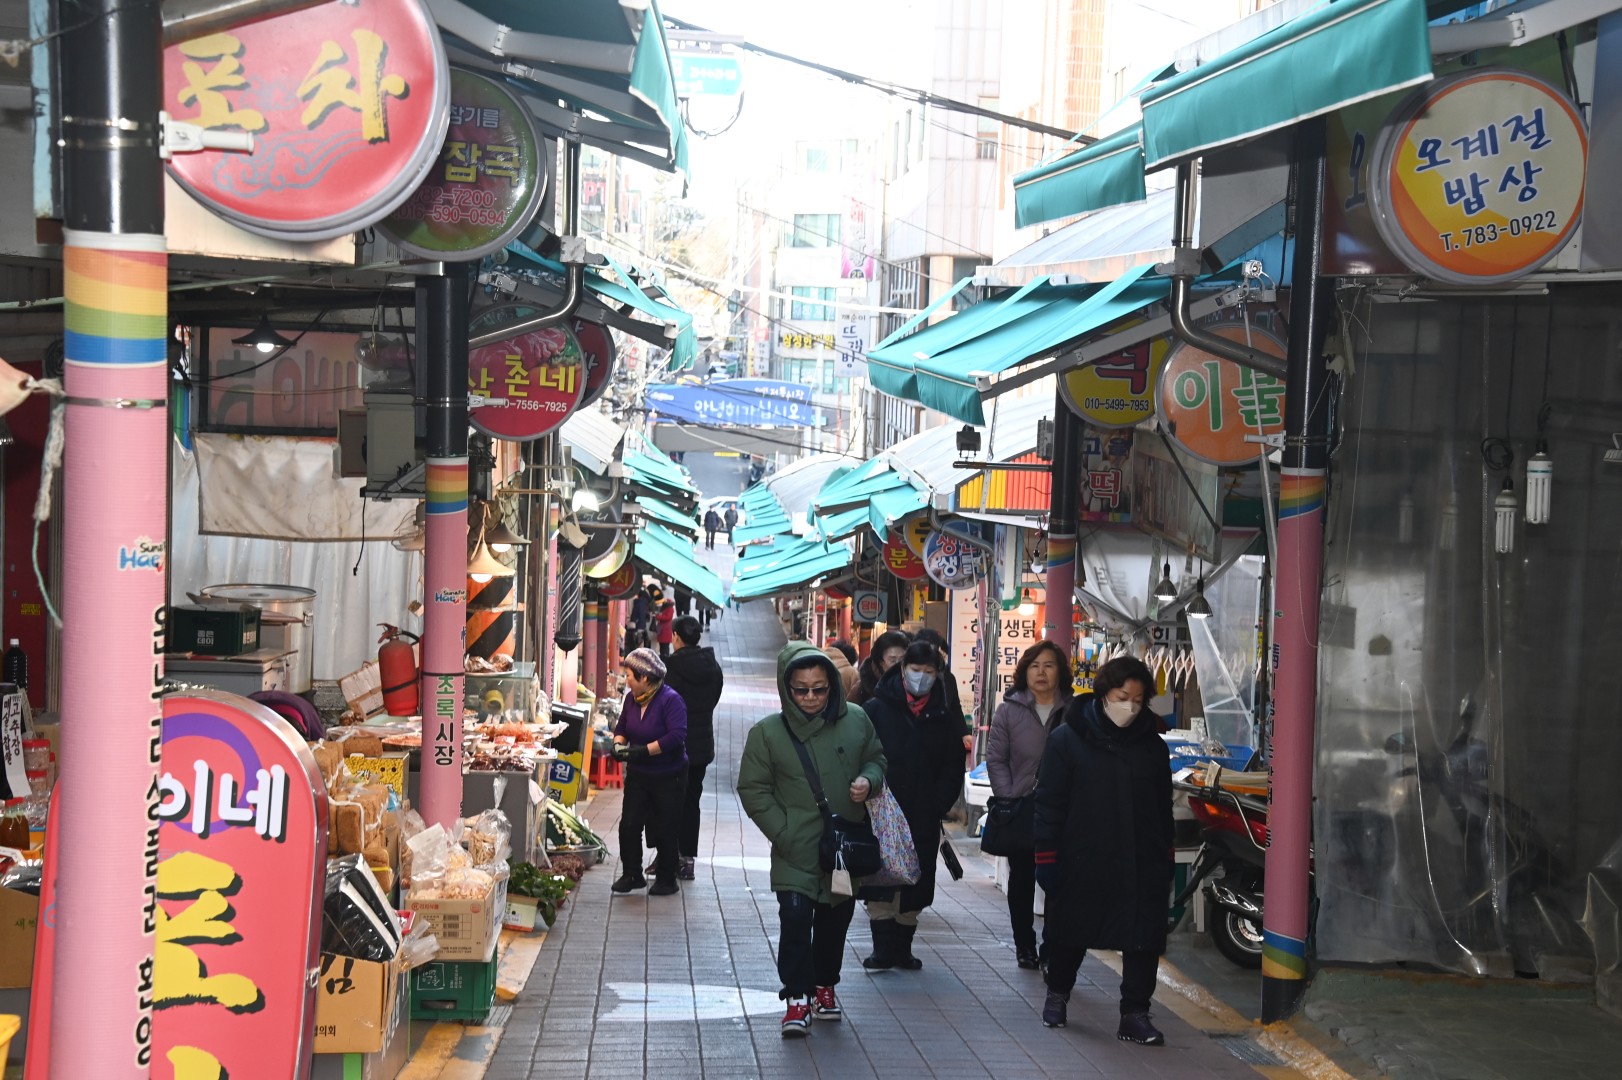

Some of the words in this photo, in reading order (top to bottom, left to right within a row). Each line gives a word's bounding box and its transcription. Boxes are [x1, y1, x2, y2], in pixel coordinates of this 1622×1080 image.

[445, 142, 520, 186] 잡곡
[1416, 108, 1552, 172] 오계절
[1444, 161, 1542, 216] 밥상
[1084, 397, 1150, 412] 010-5499-7953
[1088, 469, 1121, 508] 떡
[10, 703, 21, 757] 고추장
